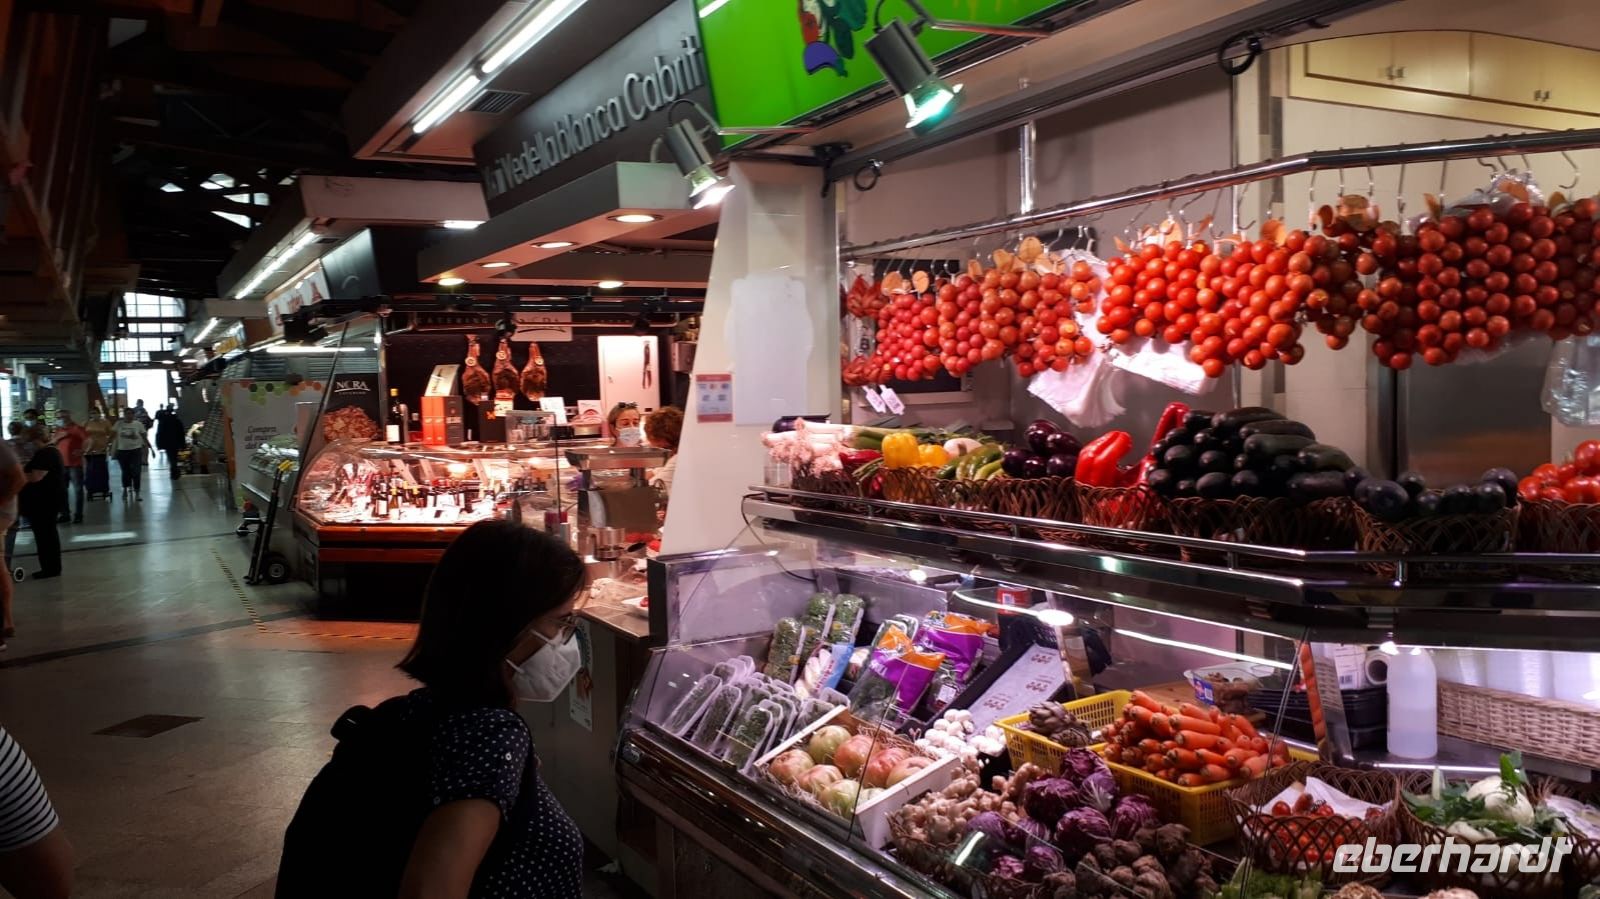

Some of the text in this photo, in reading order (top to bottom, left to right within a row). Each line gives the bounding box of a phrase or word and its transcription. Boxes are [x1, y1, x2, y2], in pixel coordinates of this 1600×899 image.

[500, 132, 560, 189] Vedella
[553, 96, 627, 161] blanca
[623, 36, 704, 121] Cabrit
